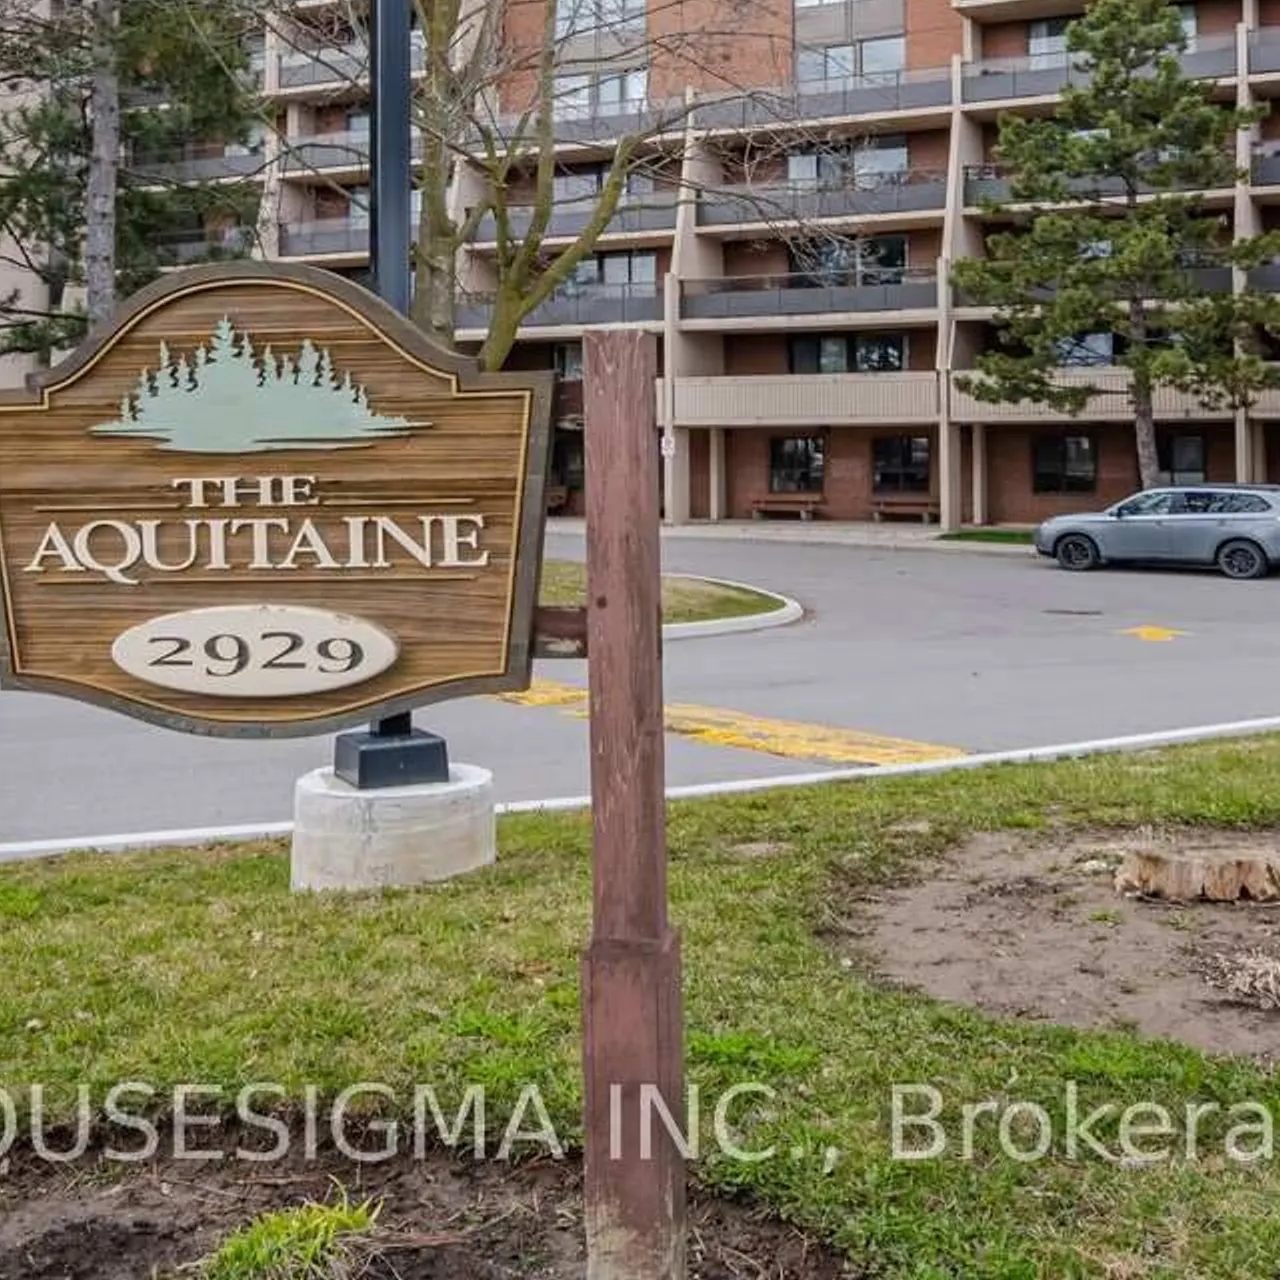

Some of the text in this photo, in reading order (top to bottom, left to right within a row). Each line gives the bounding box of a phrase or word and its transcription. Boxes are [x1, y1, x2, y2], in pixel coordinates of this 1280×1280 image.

[173, 475, 318, 508] THE
[25, 514, 490, 584] AQUITAINE
[147, 631, 363, 677] 2929
